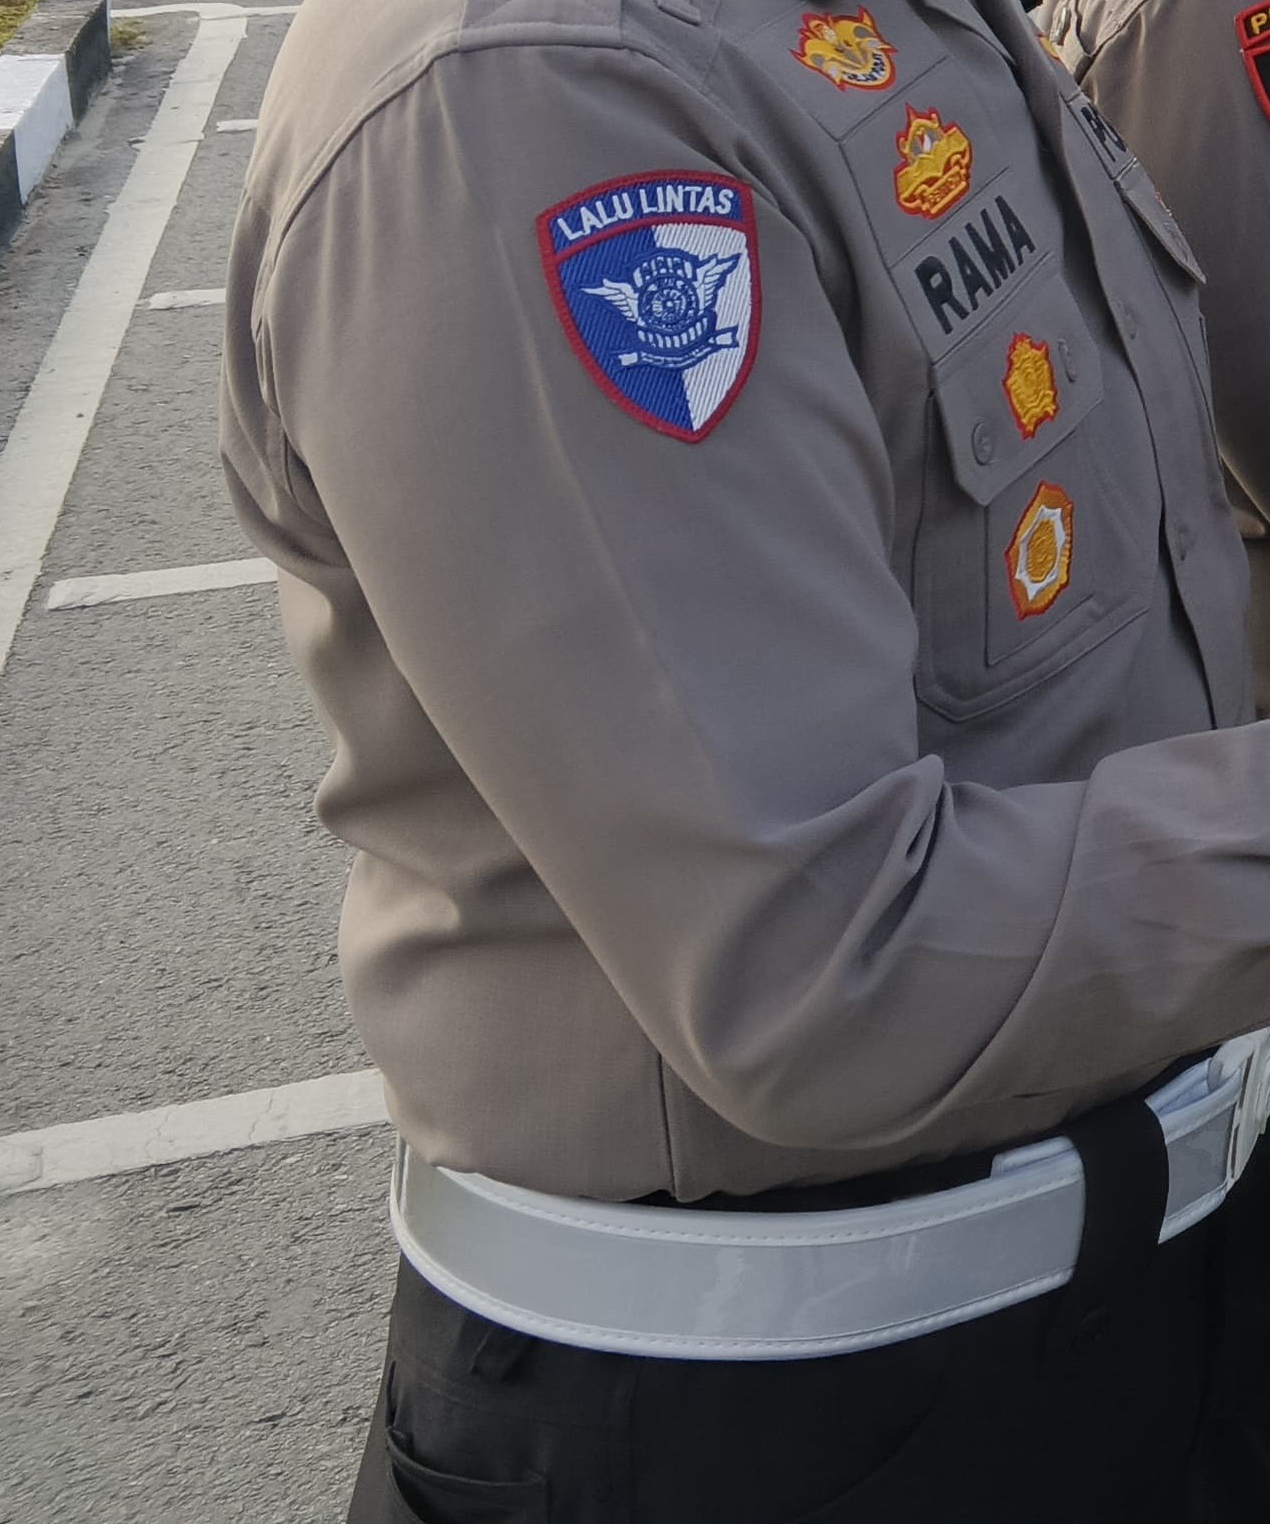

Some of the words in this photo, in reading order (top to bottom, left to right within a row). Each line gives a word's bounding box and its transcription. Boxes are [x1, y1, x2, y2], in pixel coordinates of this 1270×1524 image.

[557, 192, 634, 240] LALU
[639, 185, 734, 215] LINTAS
[914, 195, 1036, 335] RAMA
